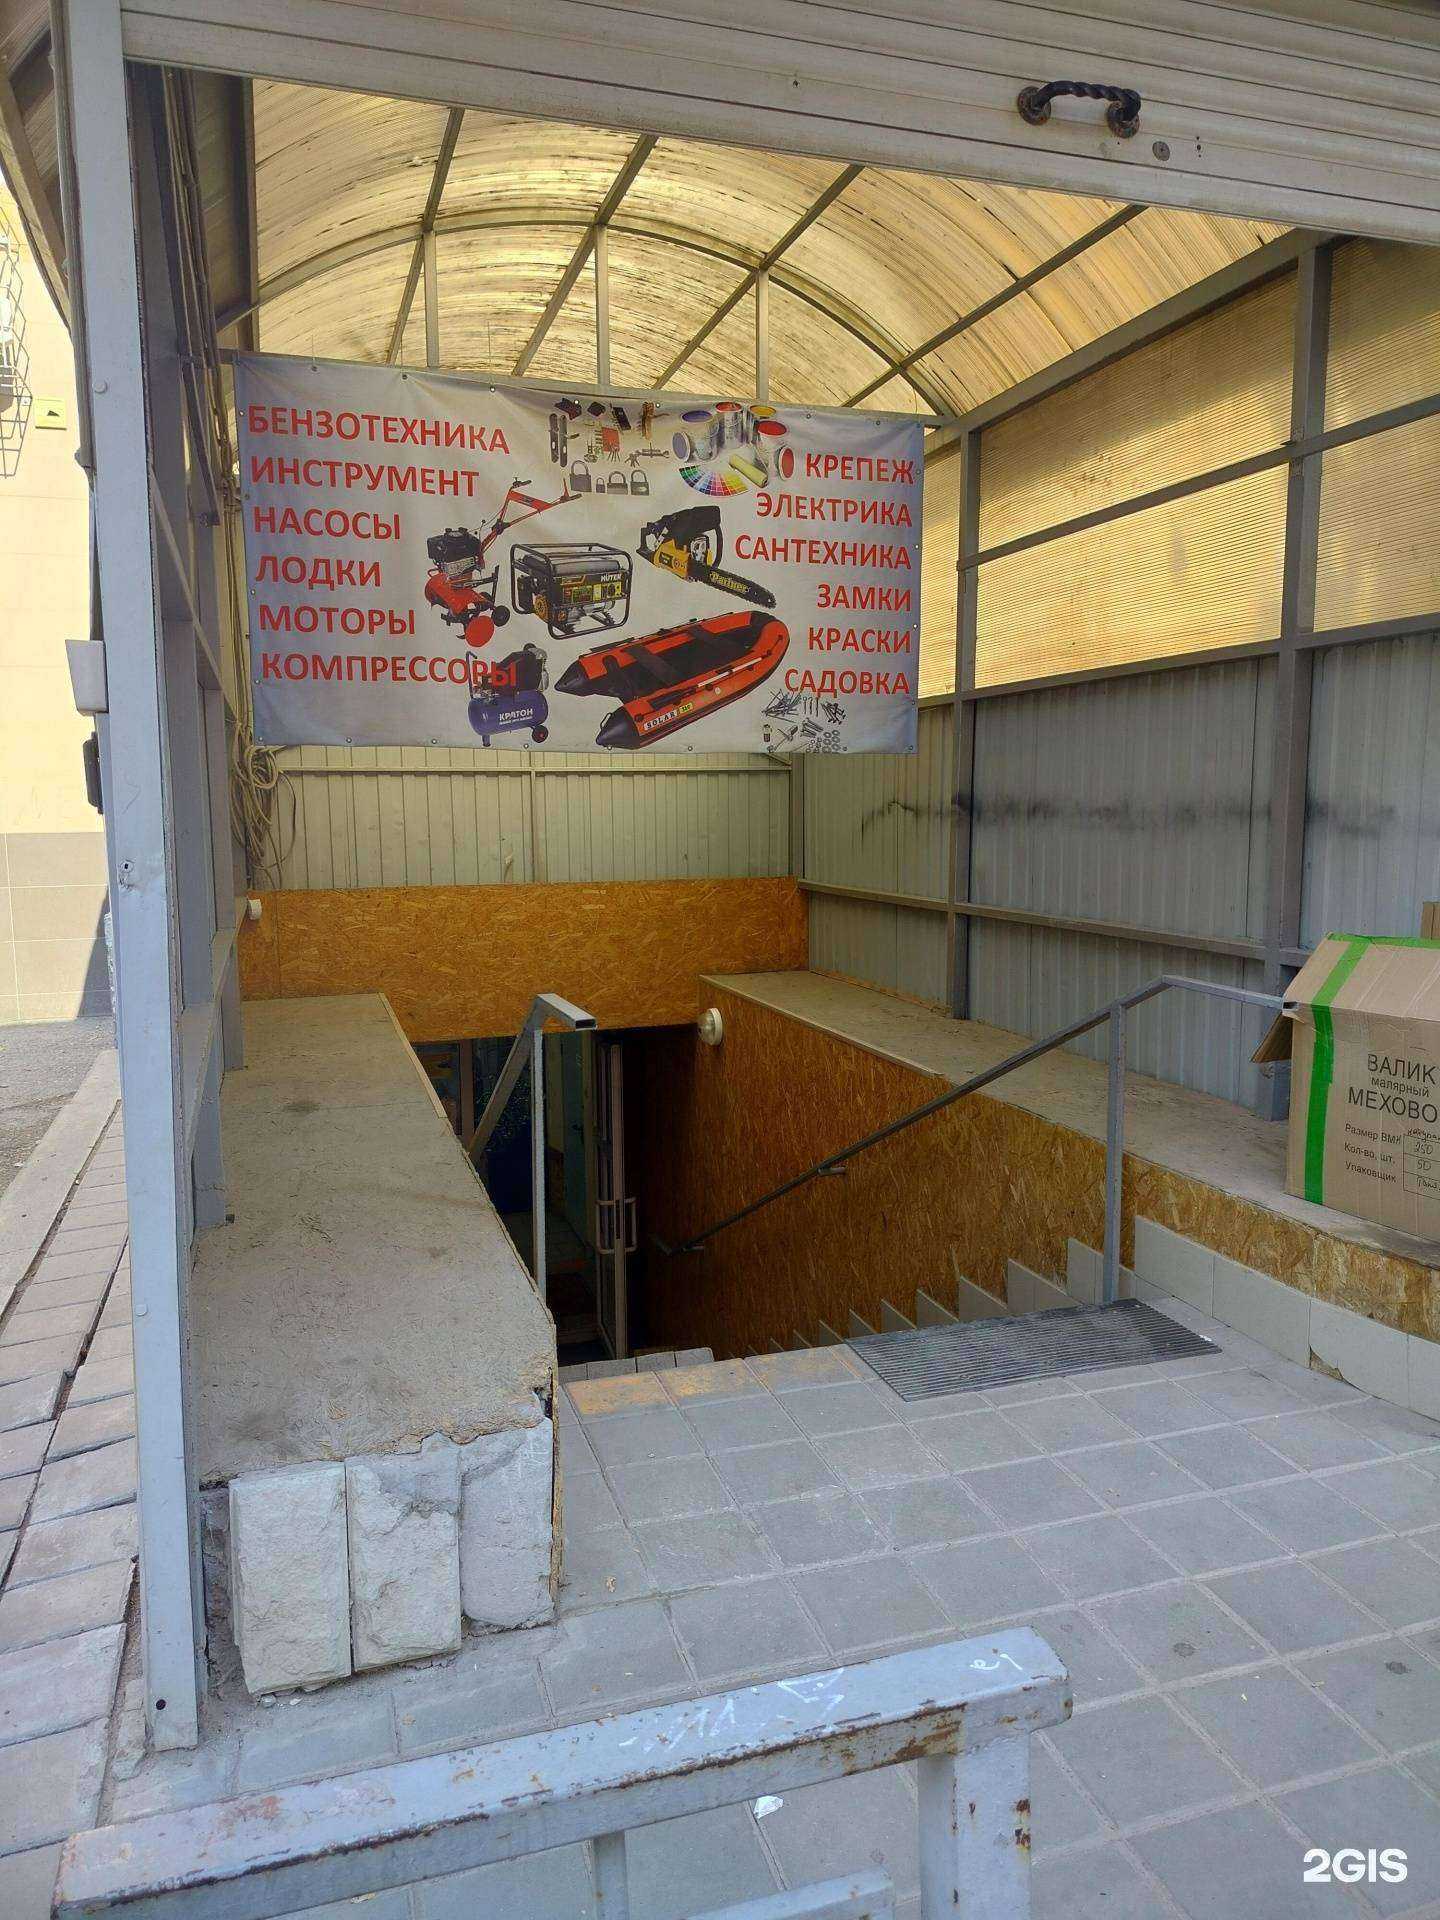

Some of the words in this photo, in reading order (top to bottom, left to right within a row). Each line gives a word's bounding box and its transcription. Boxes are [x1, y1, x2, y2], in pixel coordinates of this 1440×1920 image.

[248, 405, 511, 455] БЕНЗОТЕХНИКА
[251, 457, 480, 497] ИНСТРУМЕНТ
[804, 452, 915, 485] КРЕПЕЖ
[254, 507, 402, 540] НАСОСЫ
[755, 492, 913, 528] ЭЛЕКТРИКА
[734, 533, 912, 570] САНТЕХНИКА
[255, 556, 382, 591] ЛОДКИ
[816, 583, 912, 613] ЗАМКИ
[259, 604, 416, 636] МОТОРЫ
[808, 626, 912, 654] КРАСКИ
[262, 652, 518, 688] КОМПРЕССОРЫ
[784, 667, 910, 698] САДОВКА
[646, 711, 677, 729] SOLAR
[1367, 1053, 1437, 1085] ВАЛИК
[1371, 1077, 1430, 1098] малярный
[1345, 1123, 1379, 1141] Размер
[1345, 1161, 1397, 1183] Упаковщик
